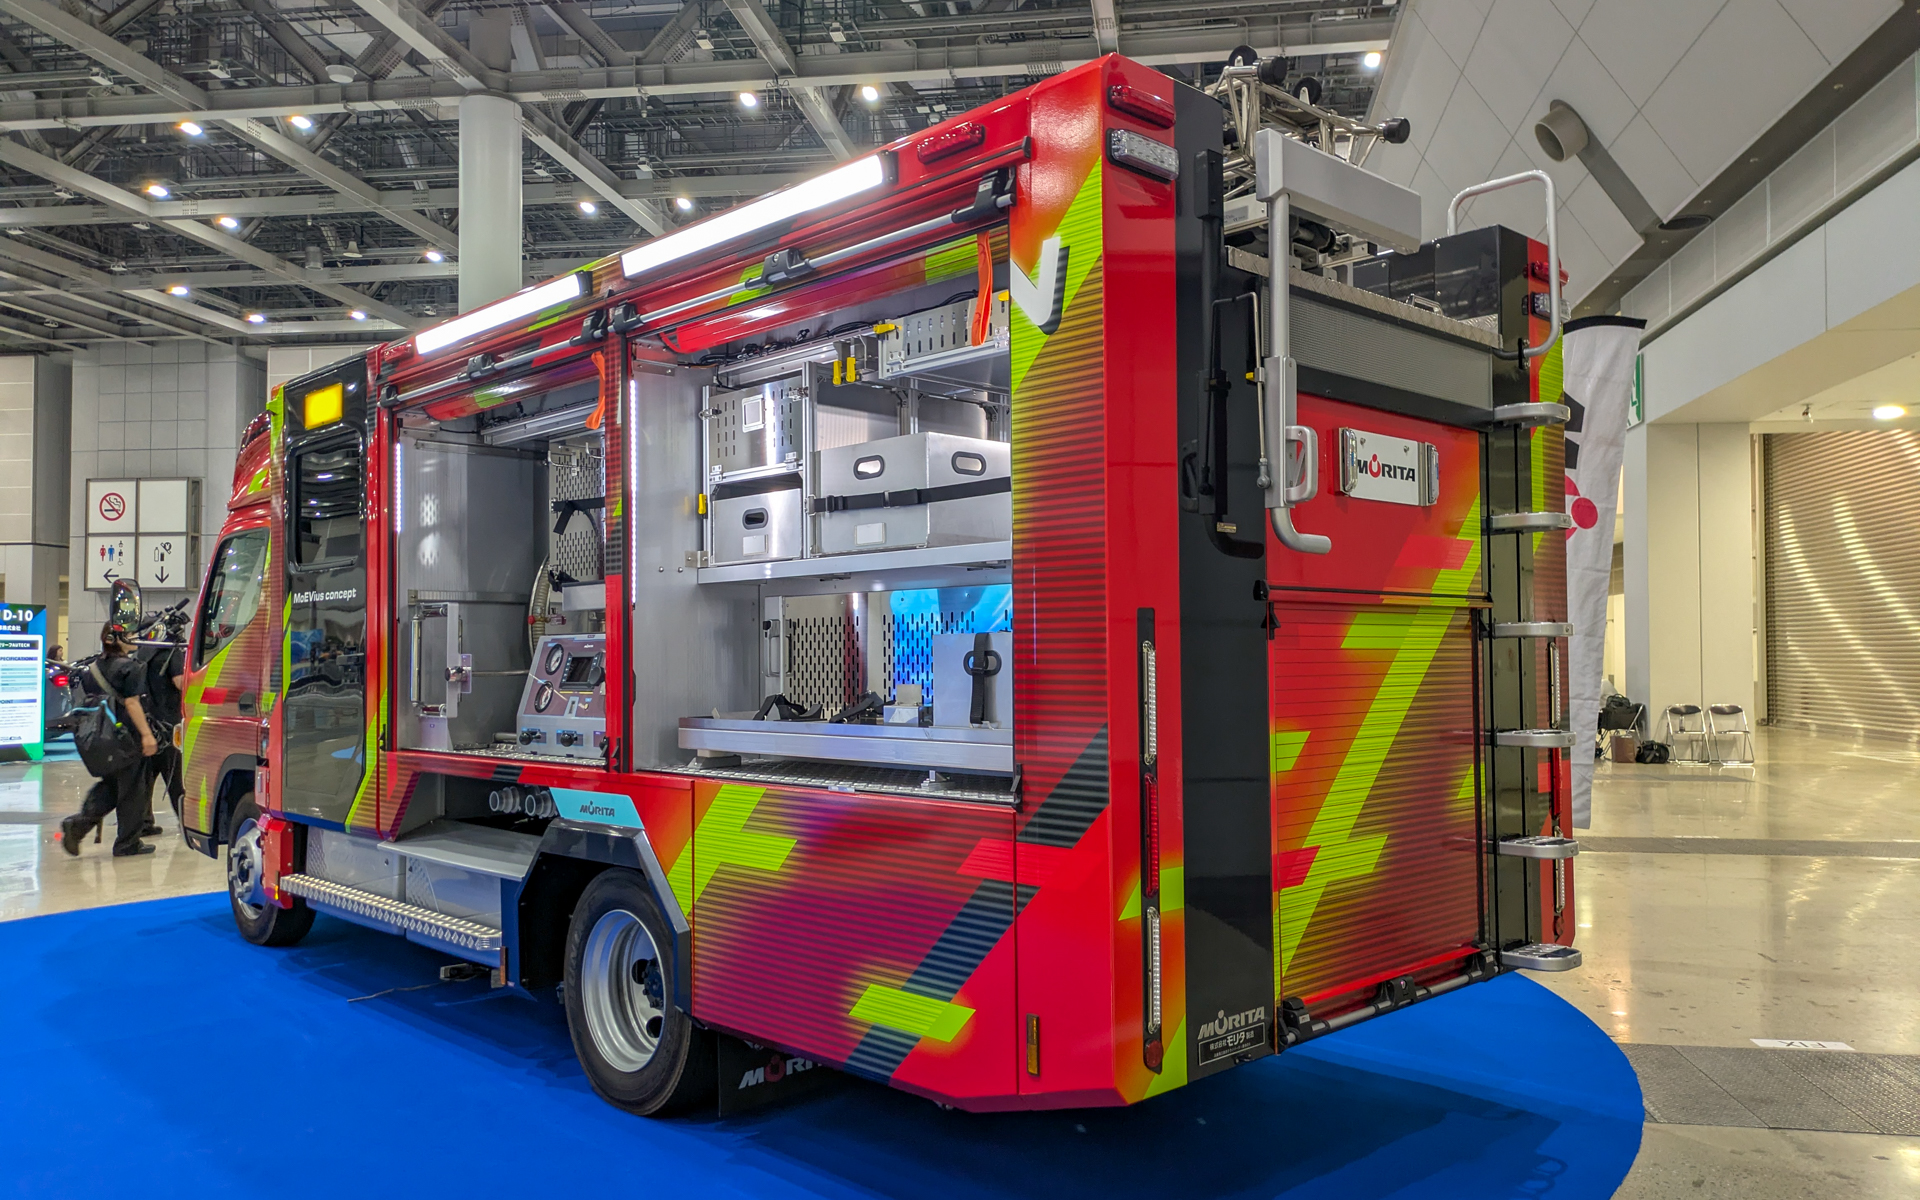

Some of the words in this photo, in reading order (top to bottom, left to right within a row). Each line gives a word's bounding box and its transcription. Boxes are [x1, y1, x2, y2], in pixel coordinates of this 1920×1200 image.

[1357, 453, 1415, 482] MORITA
[293, 590, 324, 604] MoEVius
[325, 587, 357, 602] concept
[3, 609, 34, 622] D-10
[579, 800, 615, 817] MORITA
[1197, 1006, 1265, 1040] MORITA
